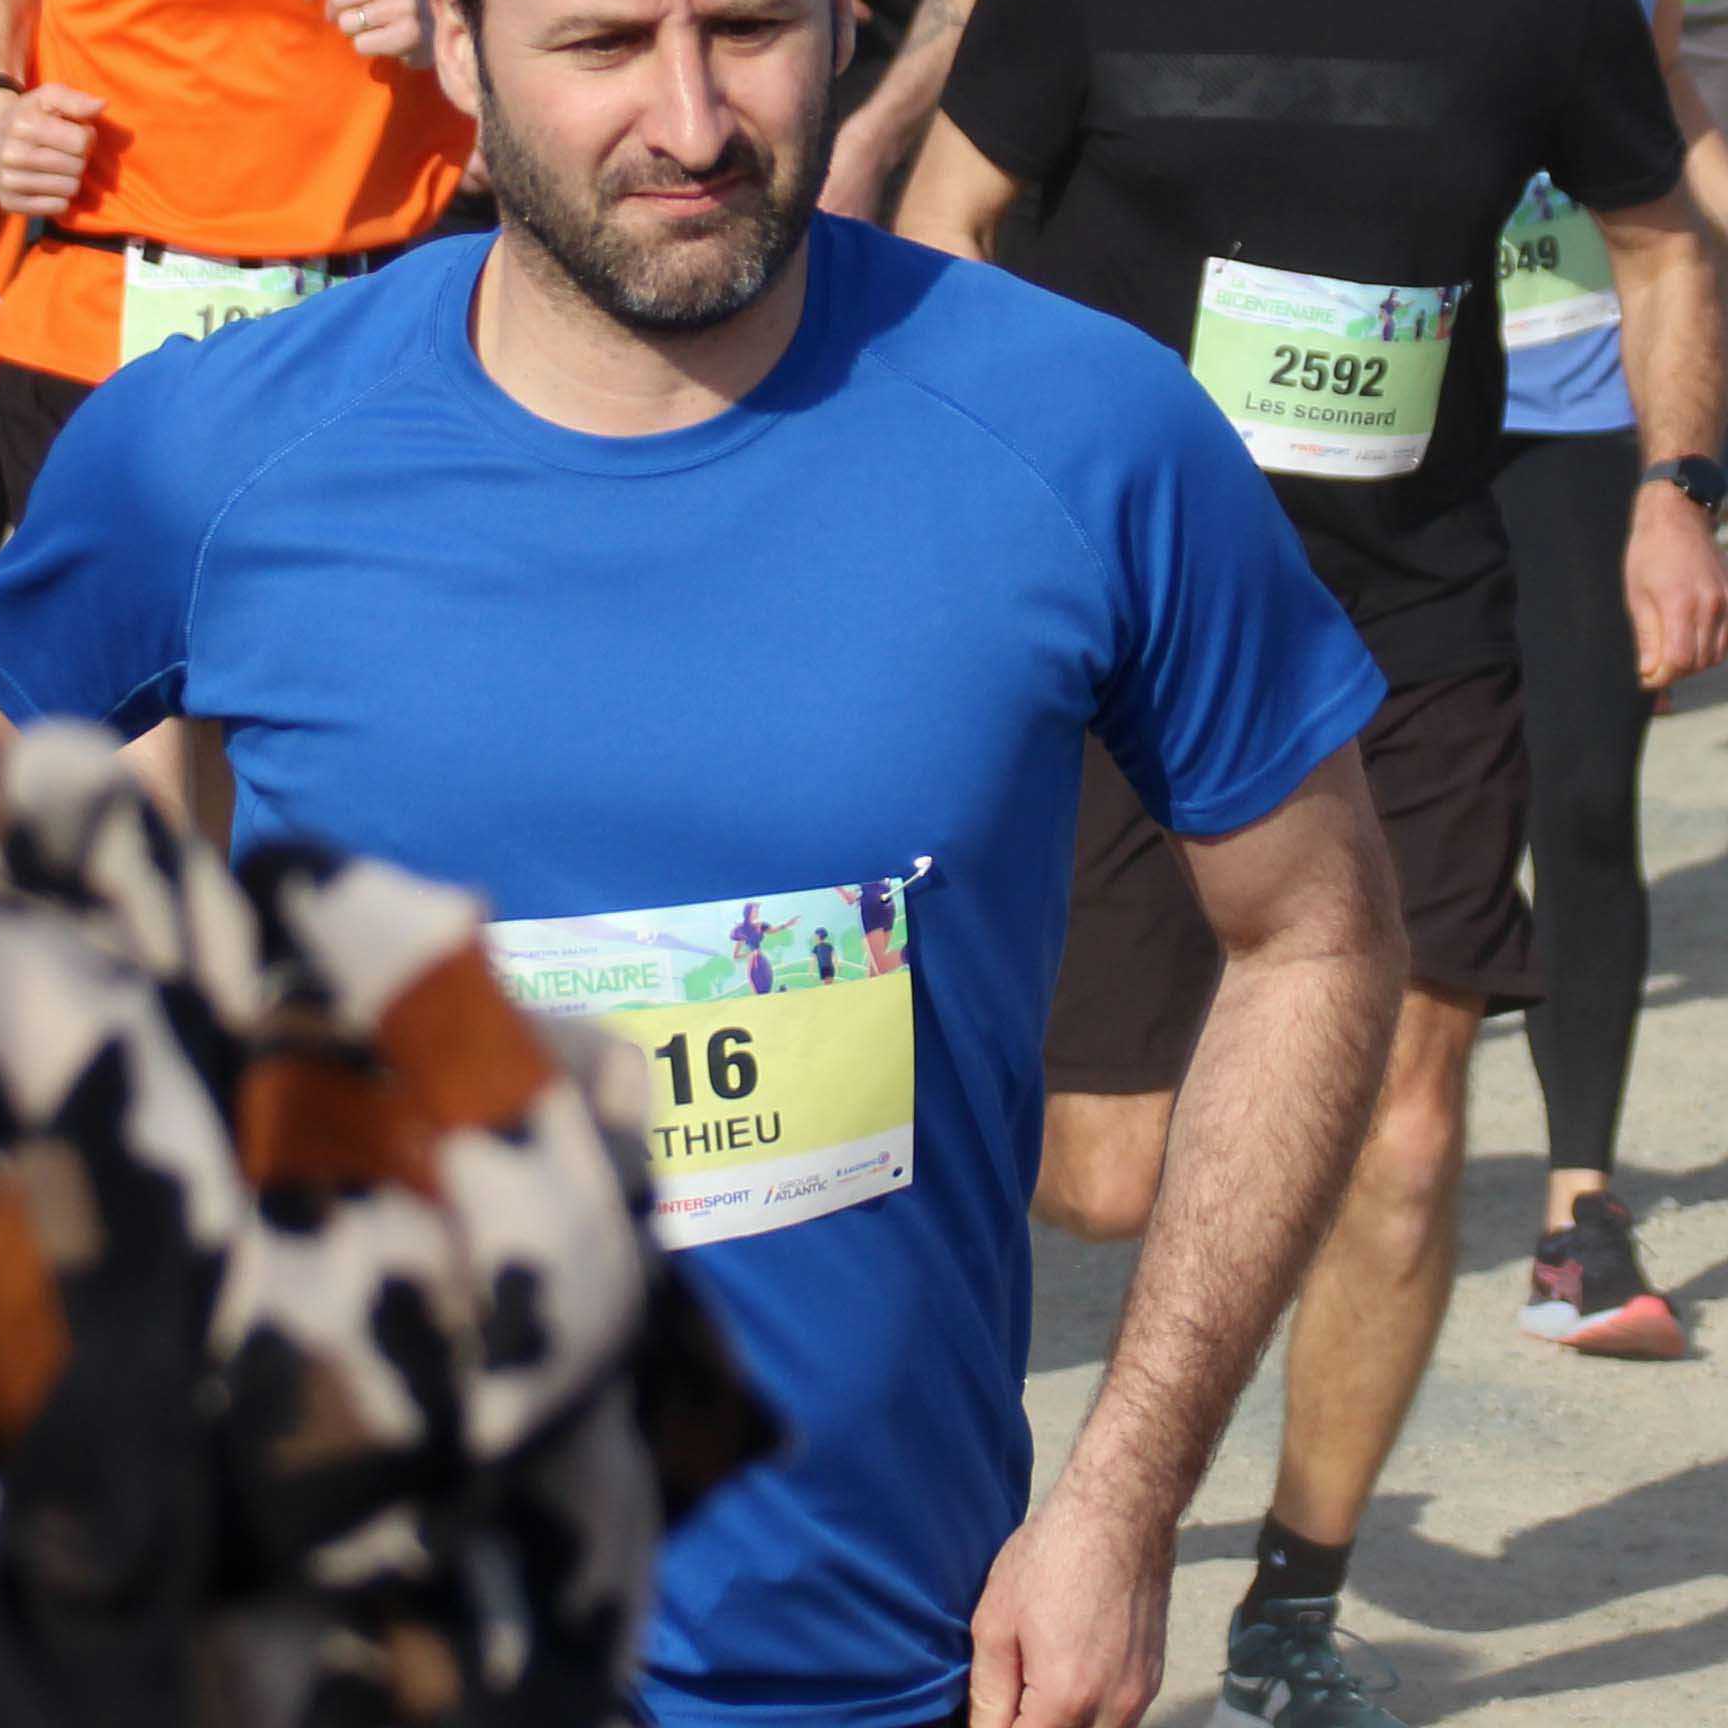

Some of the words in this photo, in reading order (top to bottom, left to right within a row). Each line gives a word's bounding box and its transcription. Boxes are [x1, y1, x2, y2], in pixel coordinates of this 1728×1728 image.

[1215, 288, 1338, 325] BICENTENAIRE
[1269, 343, 1390, 399] 2592
[1244, 390, 1288, 417] Les
[1293, 401, 1398, 428] sconnard
[654, 1025, 759, 1106] 16
[651, 1110, 783, 1159] THIEU
[656, 1188, 753, 1216] INTERSPORT
[773, 1179, 830, 1203] ATLANTIC
